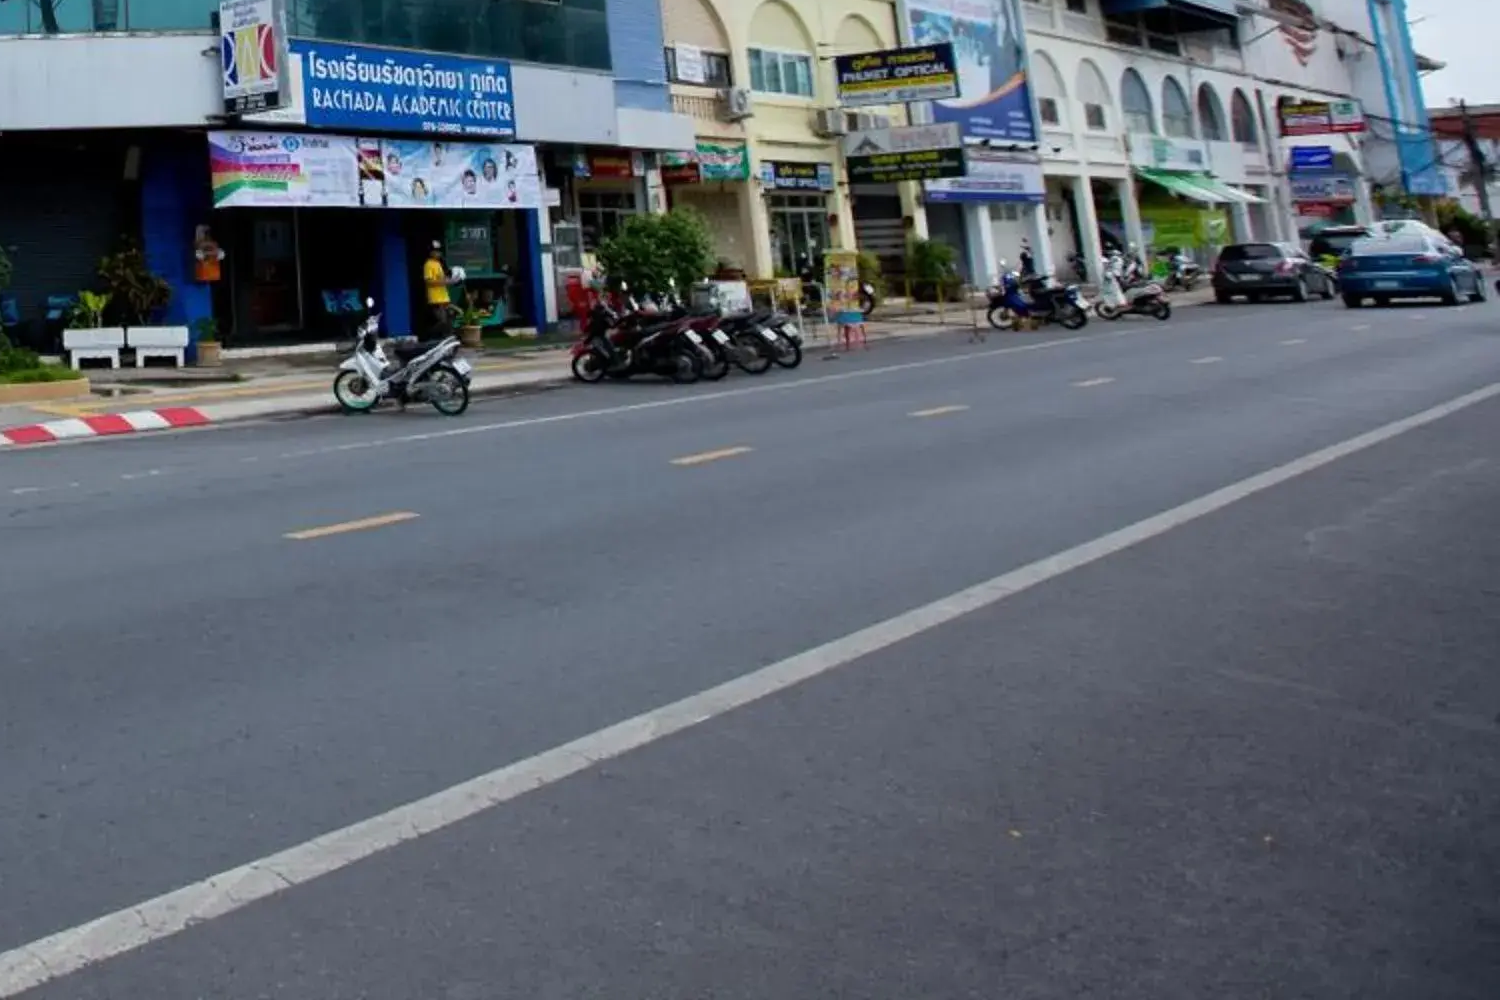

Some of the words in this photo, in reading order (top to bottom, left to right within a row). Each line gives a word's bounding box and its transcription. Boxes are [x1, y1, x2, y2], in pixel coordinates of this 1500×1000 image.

[308, 50, 464, 90] โรงเรียนรัชดาวิทยา
[470, 65, 507, 94] ภูเก็ต
[842, 67, 889, 83] PHUKET
[893, 62, 949, 78] OPTICAL
[312, 87, 386, 113] RACHADA
[392, 95, 463, 118] ACADEMIC
[467, 98, 512, 122] CENTER
